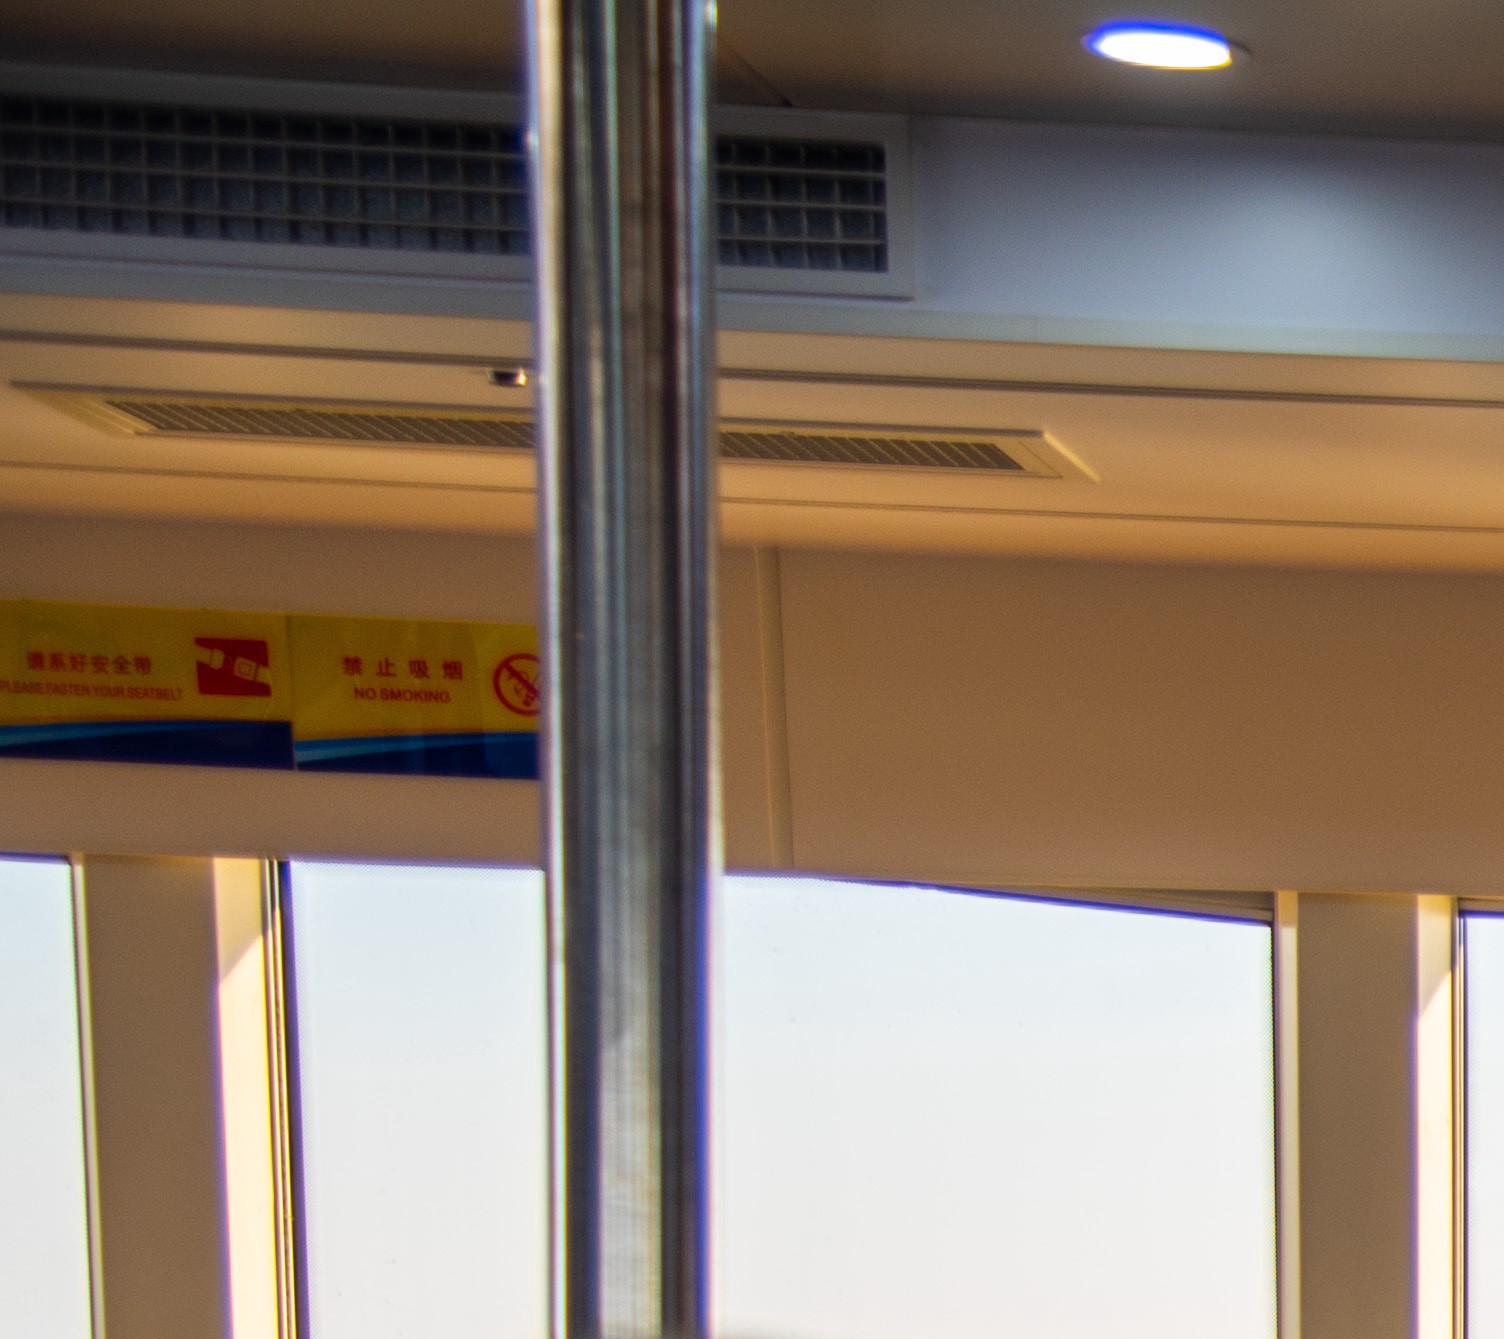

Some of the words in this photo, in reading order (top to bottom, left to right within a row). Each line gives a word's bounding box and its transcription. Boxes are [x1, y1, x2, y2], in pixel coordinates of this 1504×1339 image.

[342, 656, 463, 681] 禁止吸烟
[353, 687, 377, 700] NO
[380, 688, 451, 704] SMOKING
